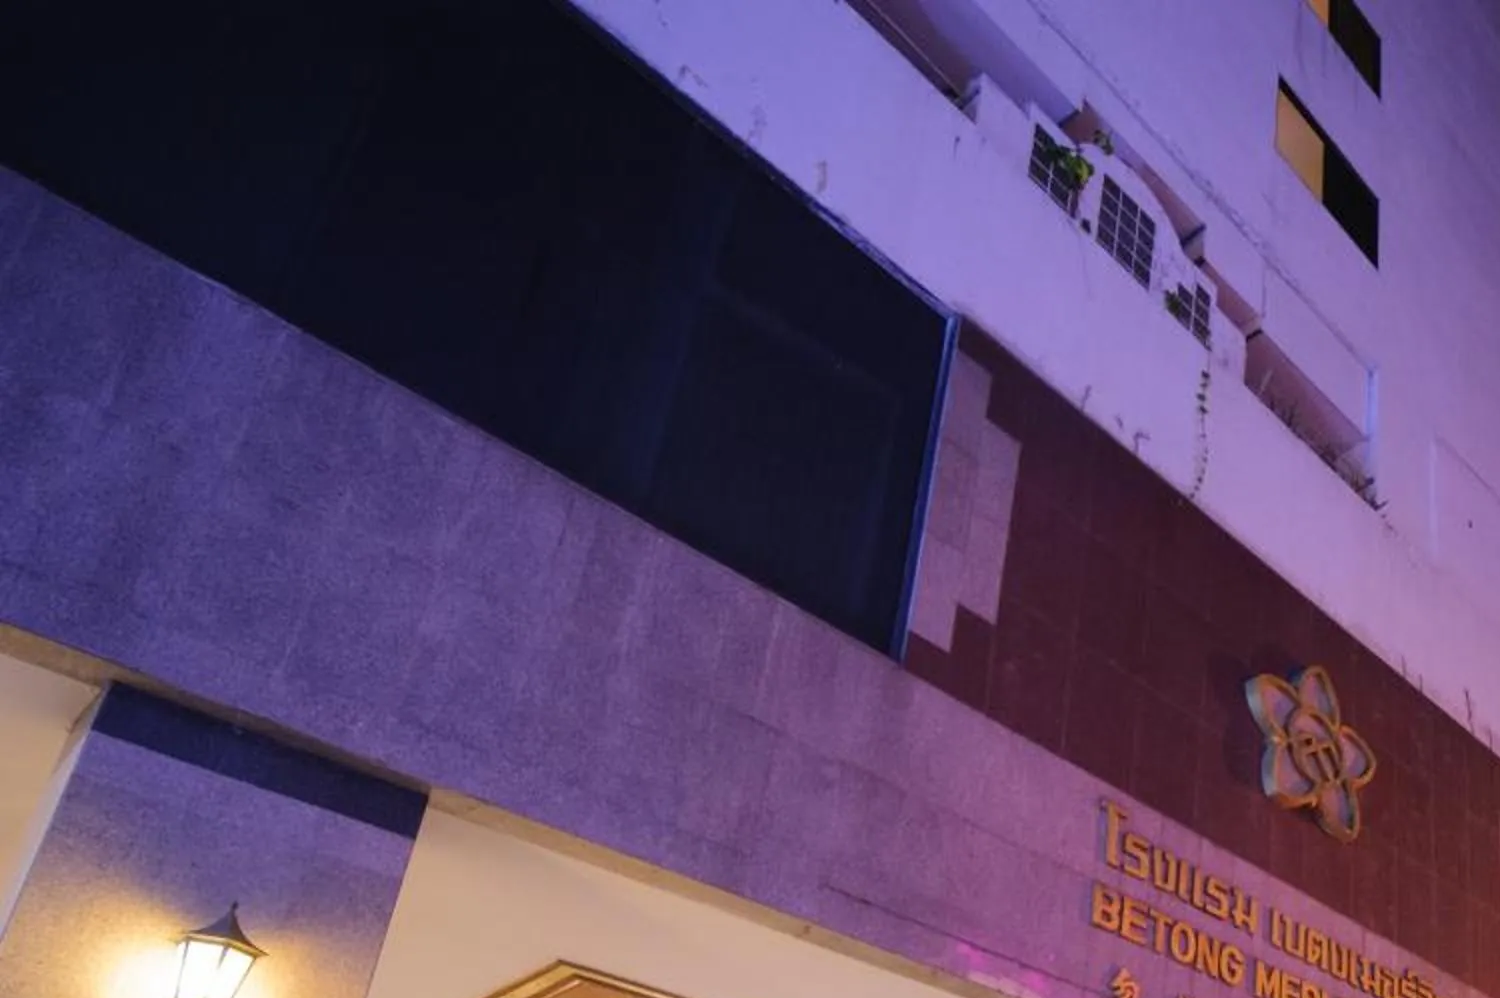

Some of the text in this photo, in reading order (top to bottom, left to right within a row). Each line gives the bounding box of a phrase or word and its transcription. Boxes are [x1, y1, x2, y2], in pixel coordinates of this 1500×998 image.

[1101, 800, 1260, 935] โรงแรม
[1091, 883, 1246, 986] BETONG
